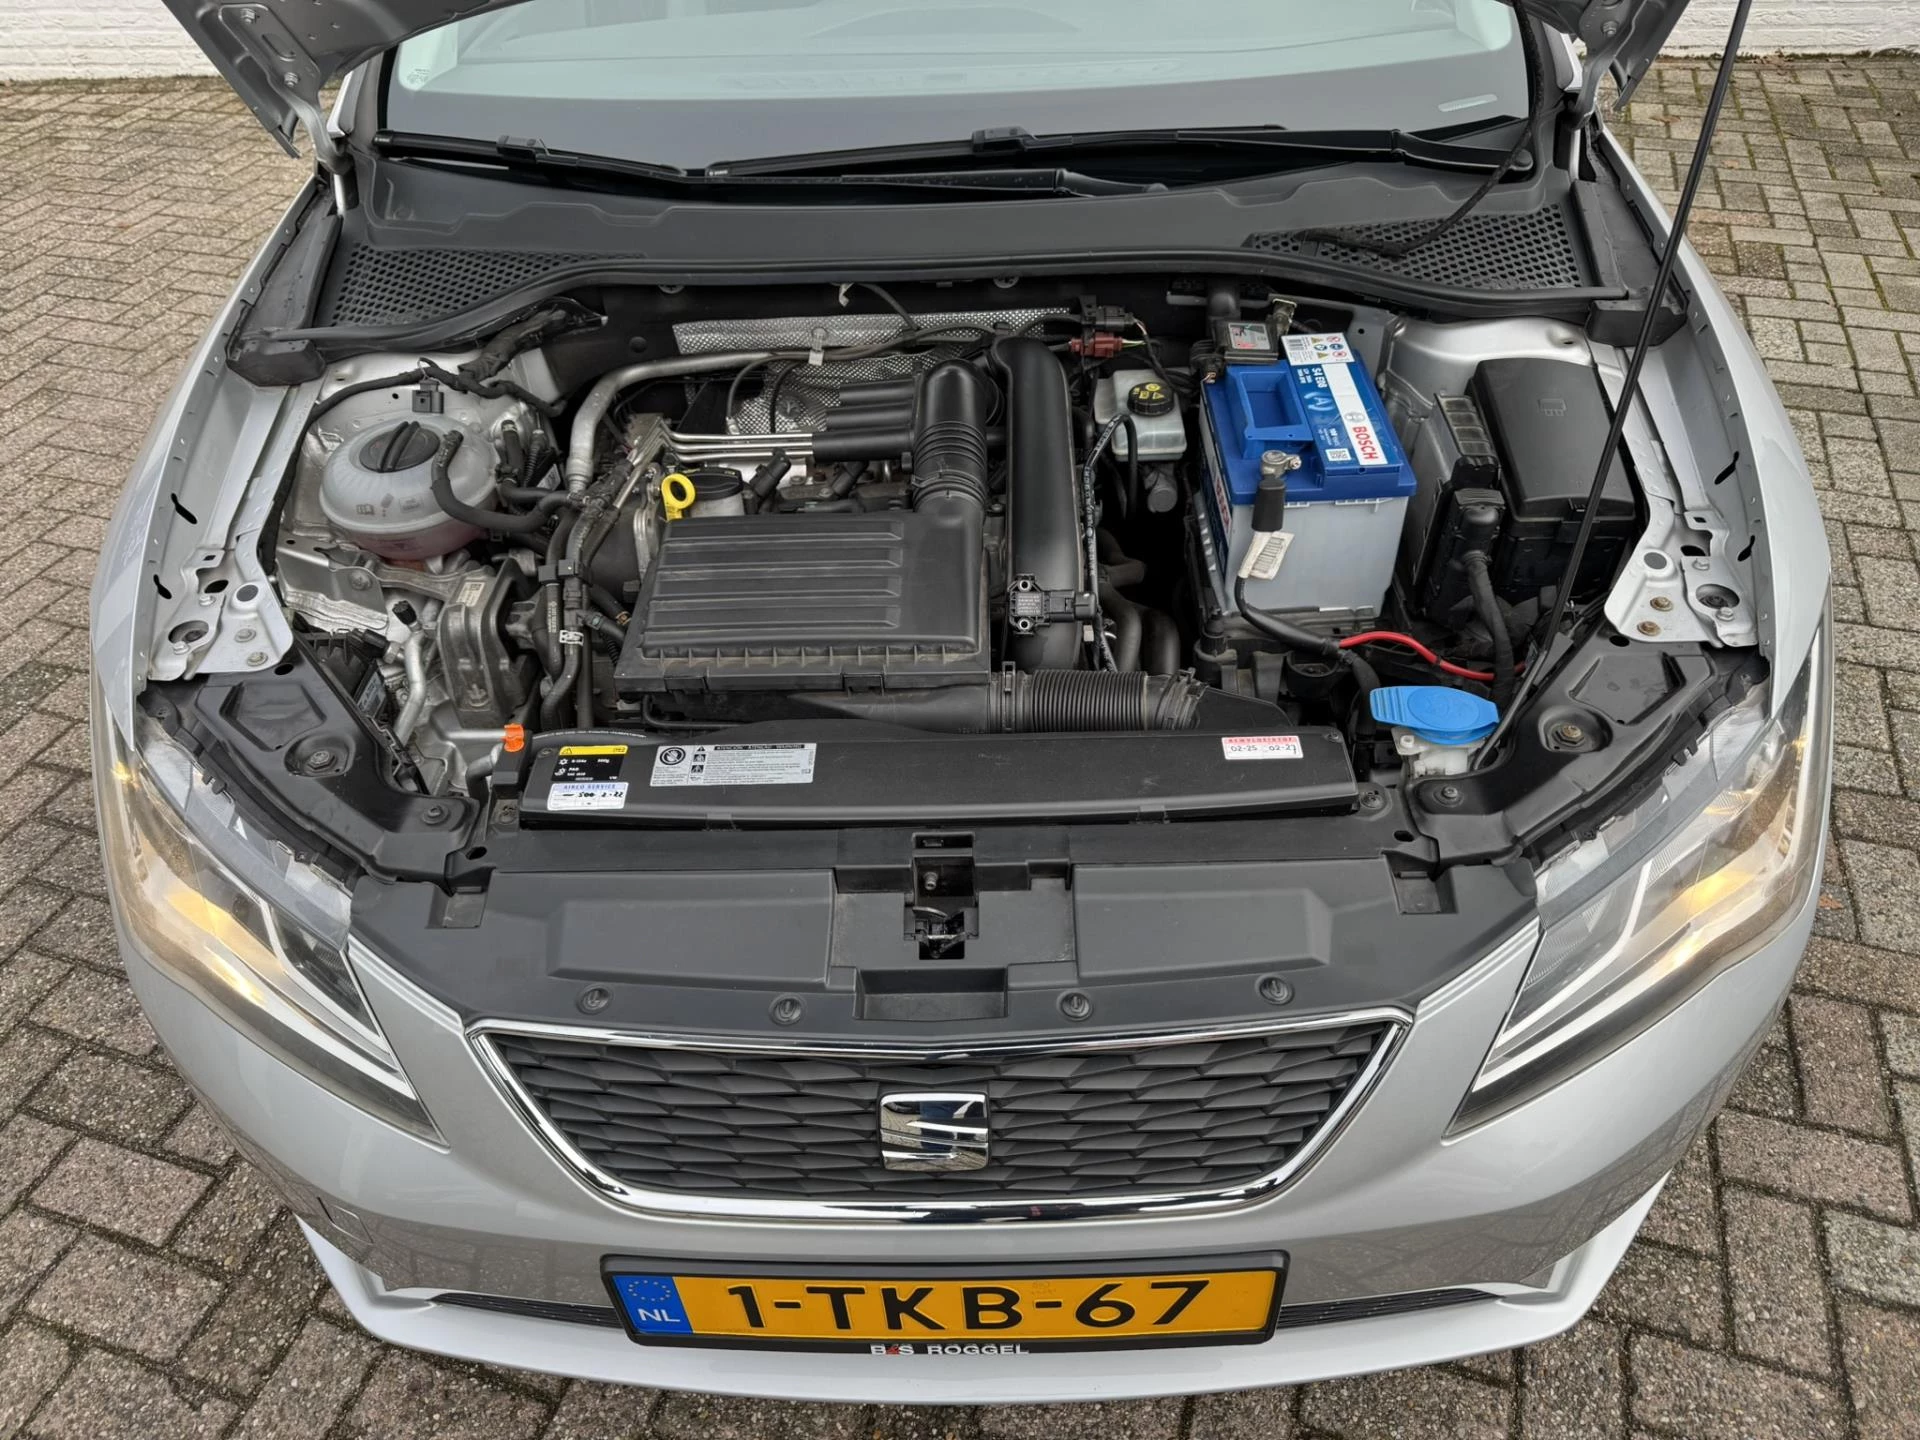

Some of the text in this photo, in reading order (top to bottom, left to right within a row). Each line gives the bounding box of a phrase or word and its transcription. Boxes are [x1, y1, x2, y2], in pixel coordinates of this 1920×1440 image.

[1353, 426, 1379, 460] BOSCH
[638, 1308, 681, 1322] NL
[727, 1279, 1210, 1330] 1-TKB-67
[927, 1344, 1030, 1355] ROGGEL
